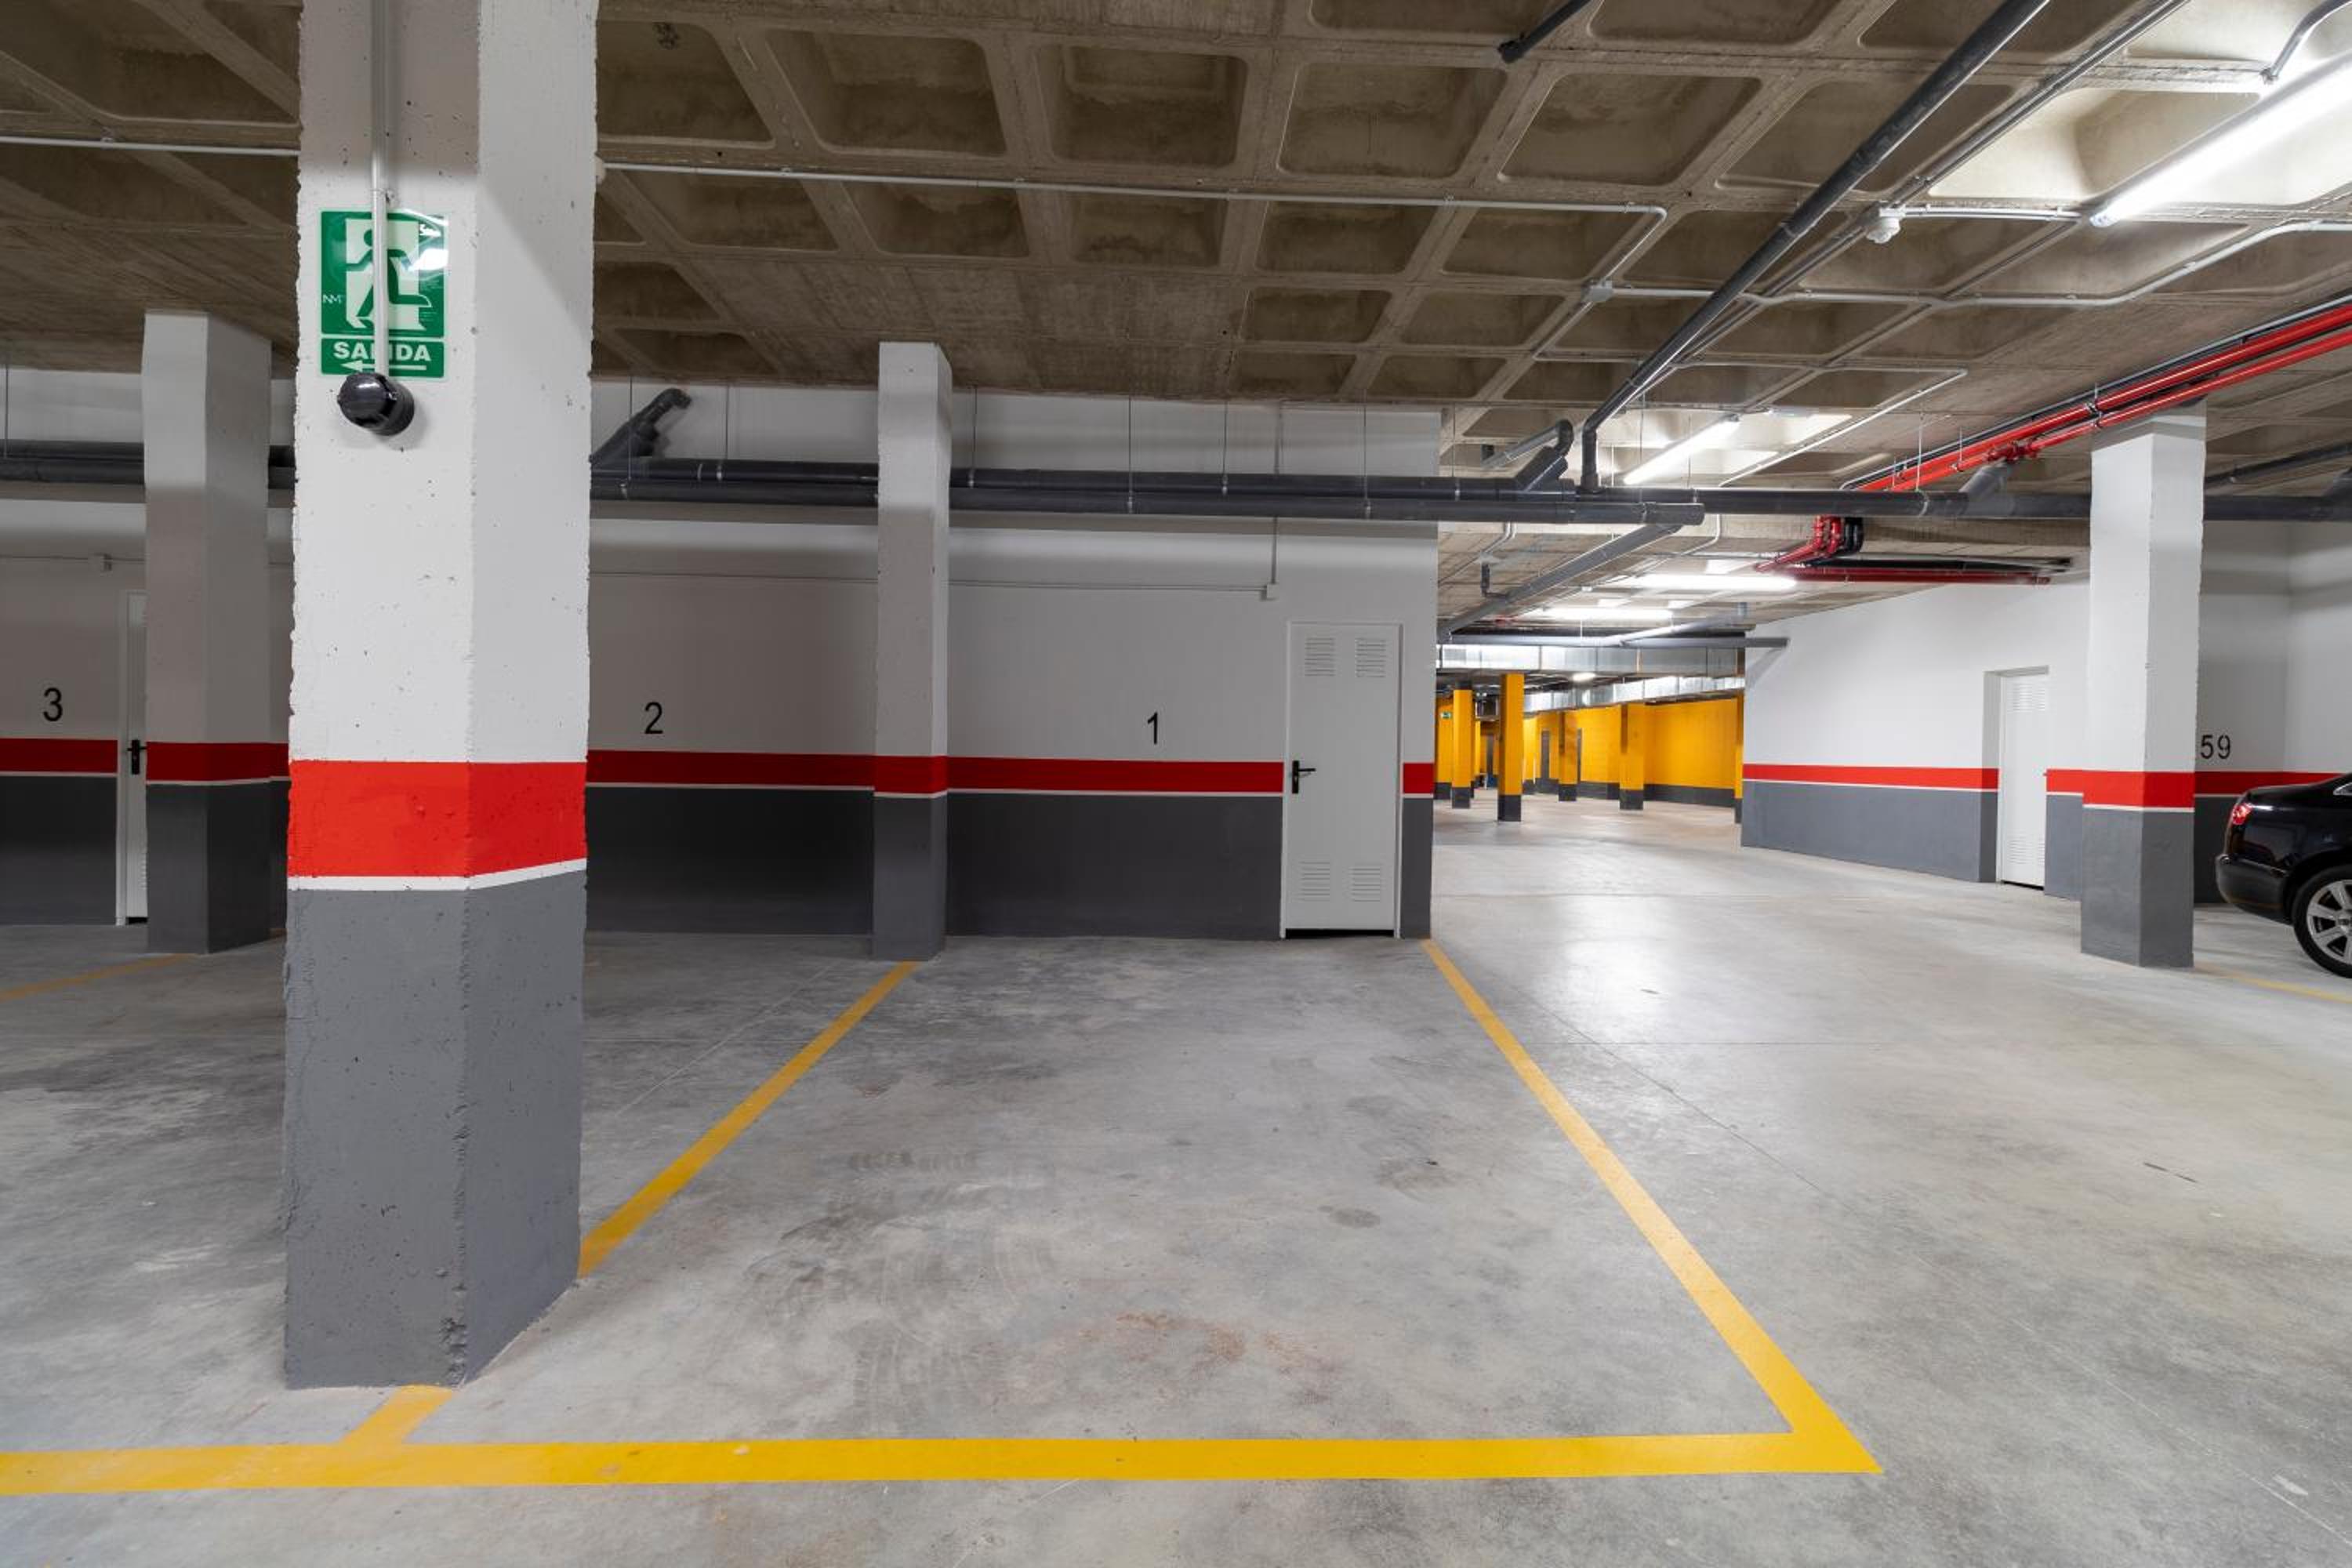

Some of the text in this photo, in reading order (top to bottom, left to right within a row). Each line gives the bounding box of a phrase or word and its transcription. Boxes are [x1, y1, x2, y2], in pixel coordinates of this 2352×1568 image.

[42, 687, 64, 722] 3
[644, 701, 664, 735] 2
[1147, 712, 1158, 745] 1
[2201, 734, 2230, 760] 59
